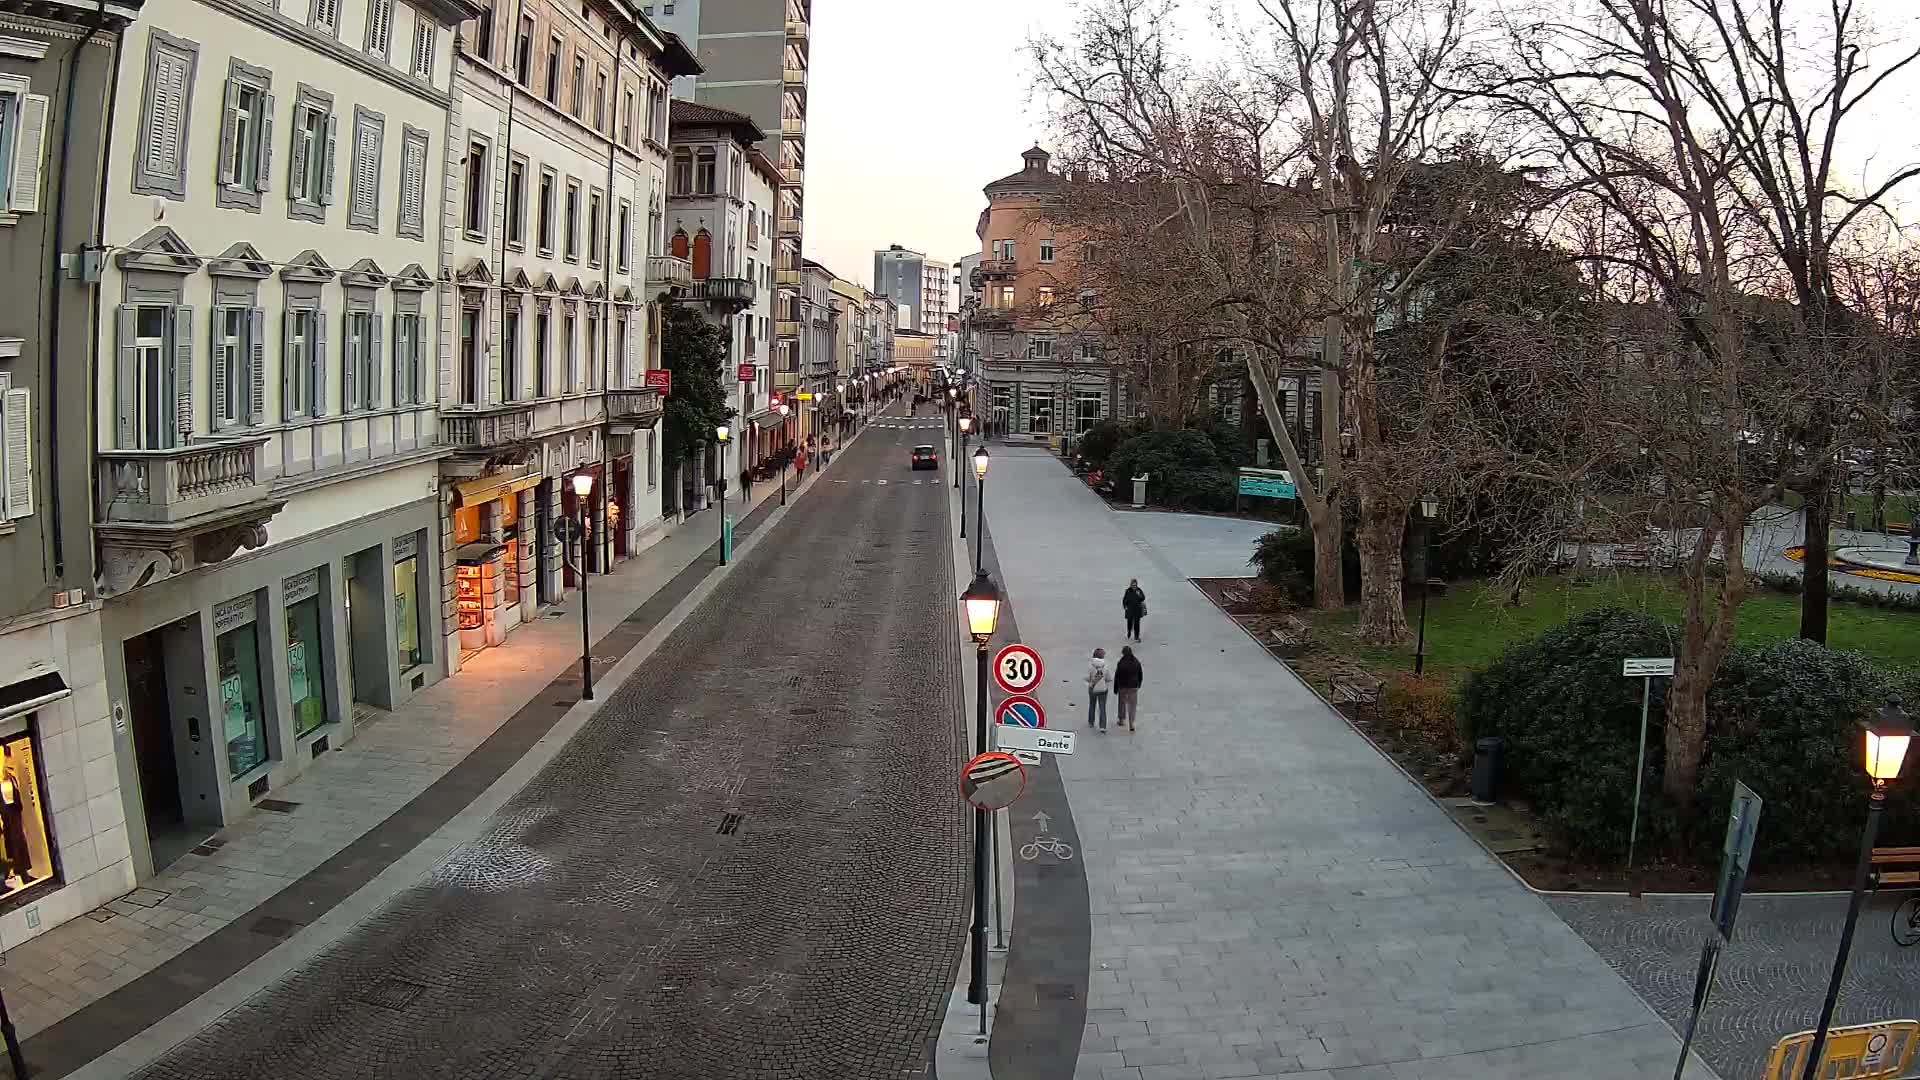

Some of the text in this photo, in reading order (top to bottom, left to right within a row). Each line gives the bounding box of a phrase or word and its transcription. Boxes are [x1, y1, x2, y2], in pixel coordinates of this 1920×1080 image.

[1005, 658, 1033, 681] 30
[221, 677, 240, 700] 130
[1038, 738, 1070, 750] Dante
